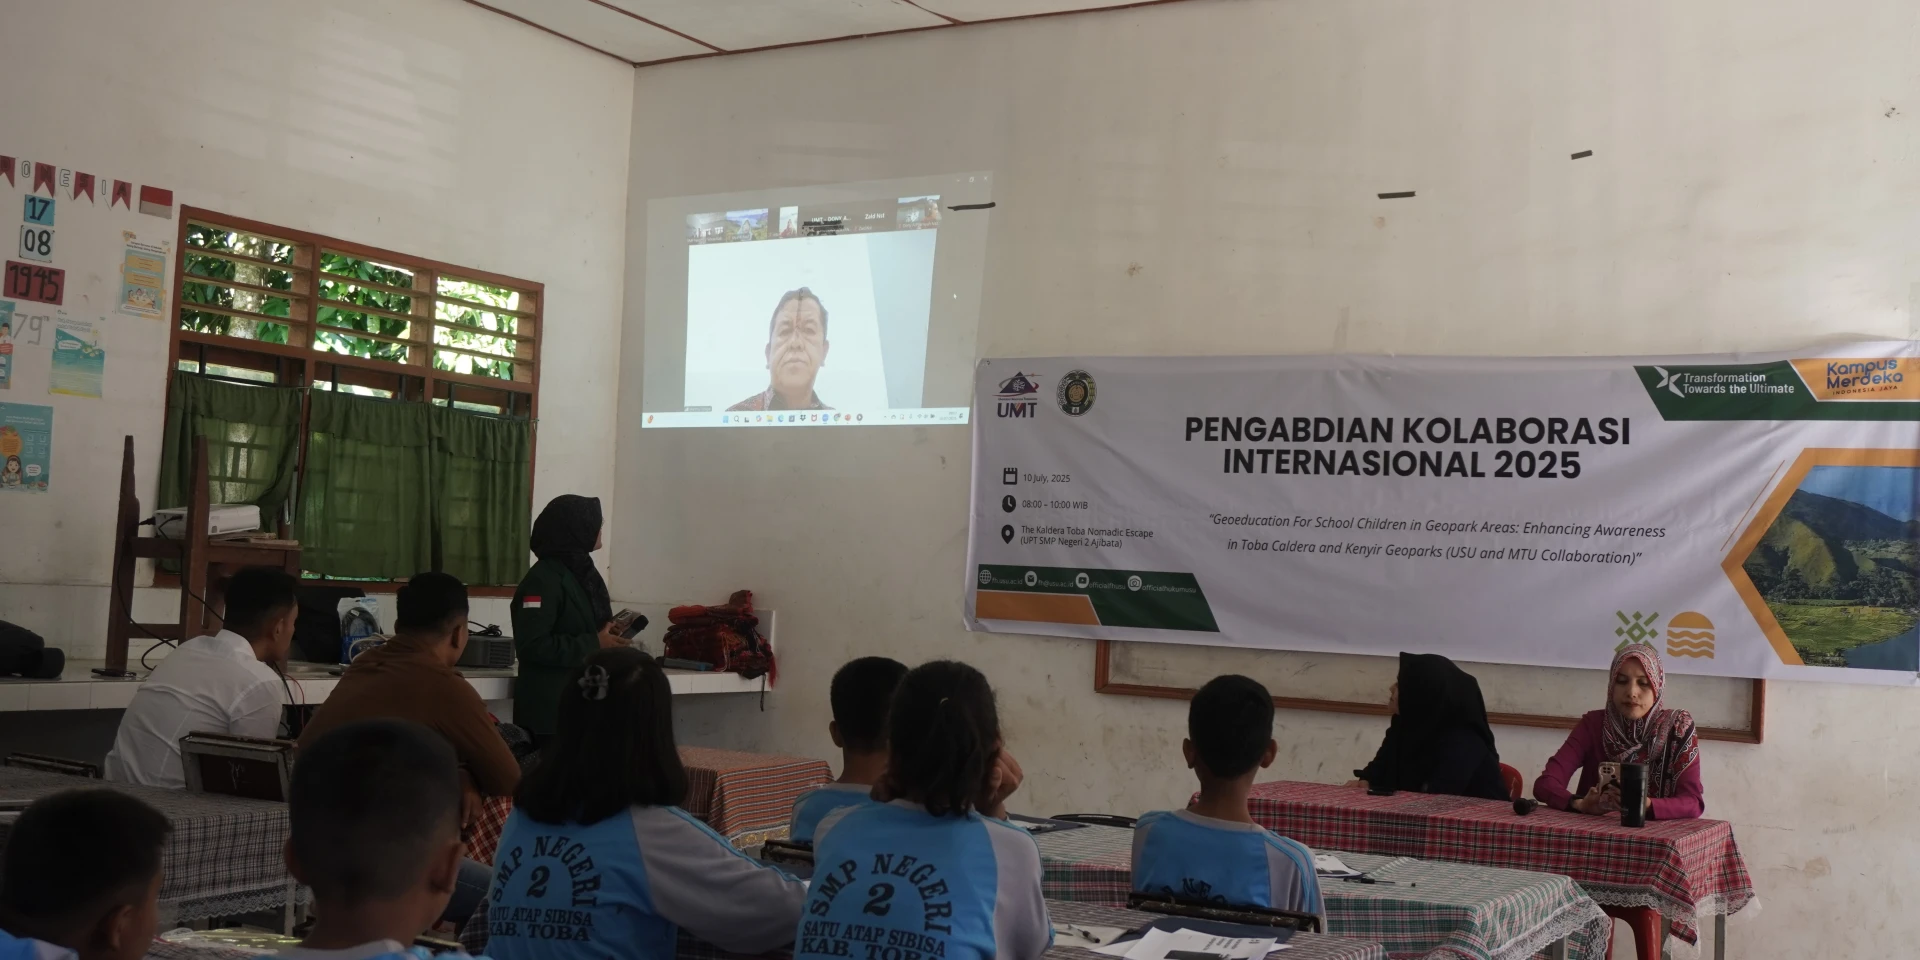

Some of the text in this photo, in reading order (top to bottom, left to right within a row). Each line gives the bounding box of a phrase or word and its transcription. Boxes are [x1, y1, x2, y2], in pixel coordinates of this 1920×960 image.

[28, 196, 51, 221] 17
[24, 228, 52, 256] 08
[9, 264, 60, 302] 1945
[1684, 373, 1766, 384] Transformation
[1827, 359, 1897, 378] Kampus
[1683, 384, 1795, 394] Towards the Ultimate
[1826, 371, 1904, 390] Merdeka
[1832, 385, 1899, 396] INDONESIA JAYA
[997, 402, 1038, 418] UMT
[1185, 416, 1631, 446] PENGABDIAN KOLABORASI
[1223, 448, 1582, 480] INTERNASIONAL 2025
[1023, 473, 1071, 484] 10 July, 2025
[1022, 500, 1042, 509] 08:00
[1050, 500, 1071, 509] 10:00
[1072, 501, 1089, 510] WIB
[1021, 525, 1154, 540] The Kaldera Toba Nomadic Escape
[1293, 515, 1312, 529] For
[1315, 515, 1354, 530] School
[1357, 516, 1408, 532] Children
[1410, 518, 1422, 532] in
[1425, 519, 1477, 536] Geopark
[1480, 521, 1520, 535] Areas:
[1523, 521, 1592, 538] Enhancing
[1594, 523, 1666, 538] Awareness
[1020, 536, 1123, 549] (UPT SMP Negeri 2 Ajibata)
[1227, 538, 1238, 551] in
[1241, 538, 1269, 552] Toba
[1272, 539, 1316, 554] Caldera
[1319, 541, 1342, 555] and
[1345, 542, 1383, 559] Kenyir
[1385, 543, 1443, 561] Geoparks
[1446, 544, 1477, 561] (USU
[1479, 546, 1504, 560] and
[1507, 547, 1538, 561] MTU
[492, 835, 602, 907] SMP NEGERI
[526, 865, 550, 898] 2
[810, 853, 952, 935] SMP NEGERI
[862, 882, 895, 917] 2
[511, 907, 542, 923] ATAP
[543, 908, 593, 927] SIBISA
[489, 921, 590, 941] KAB. TOBA
[803, 920, 945, 958] SATU ATAP SIBISA
[800, 937, 854, 958] KAB.
